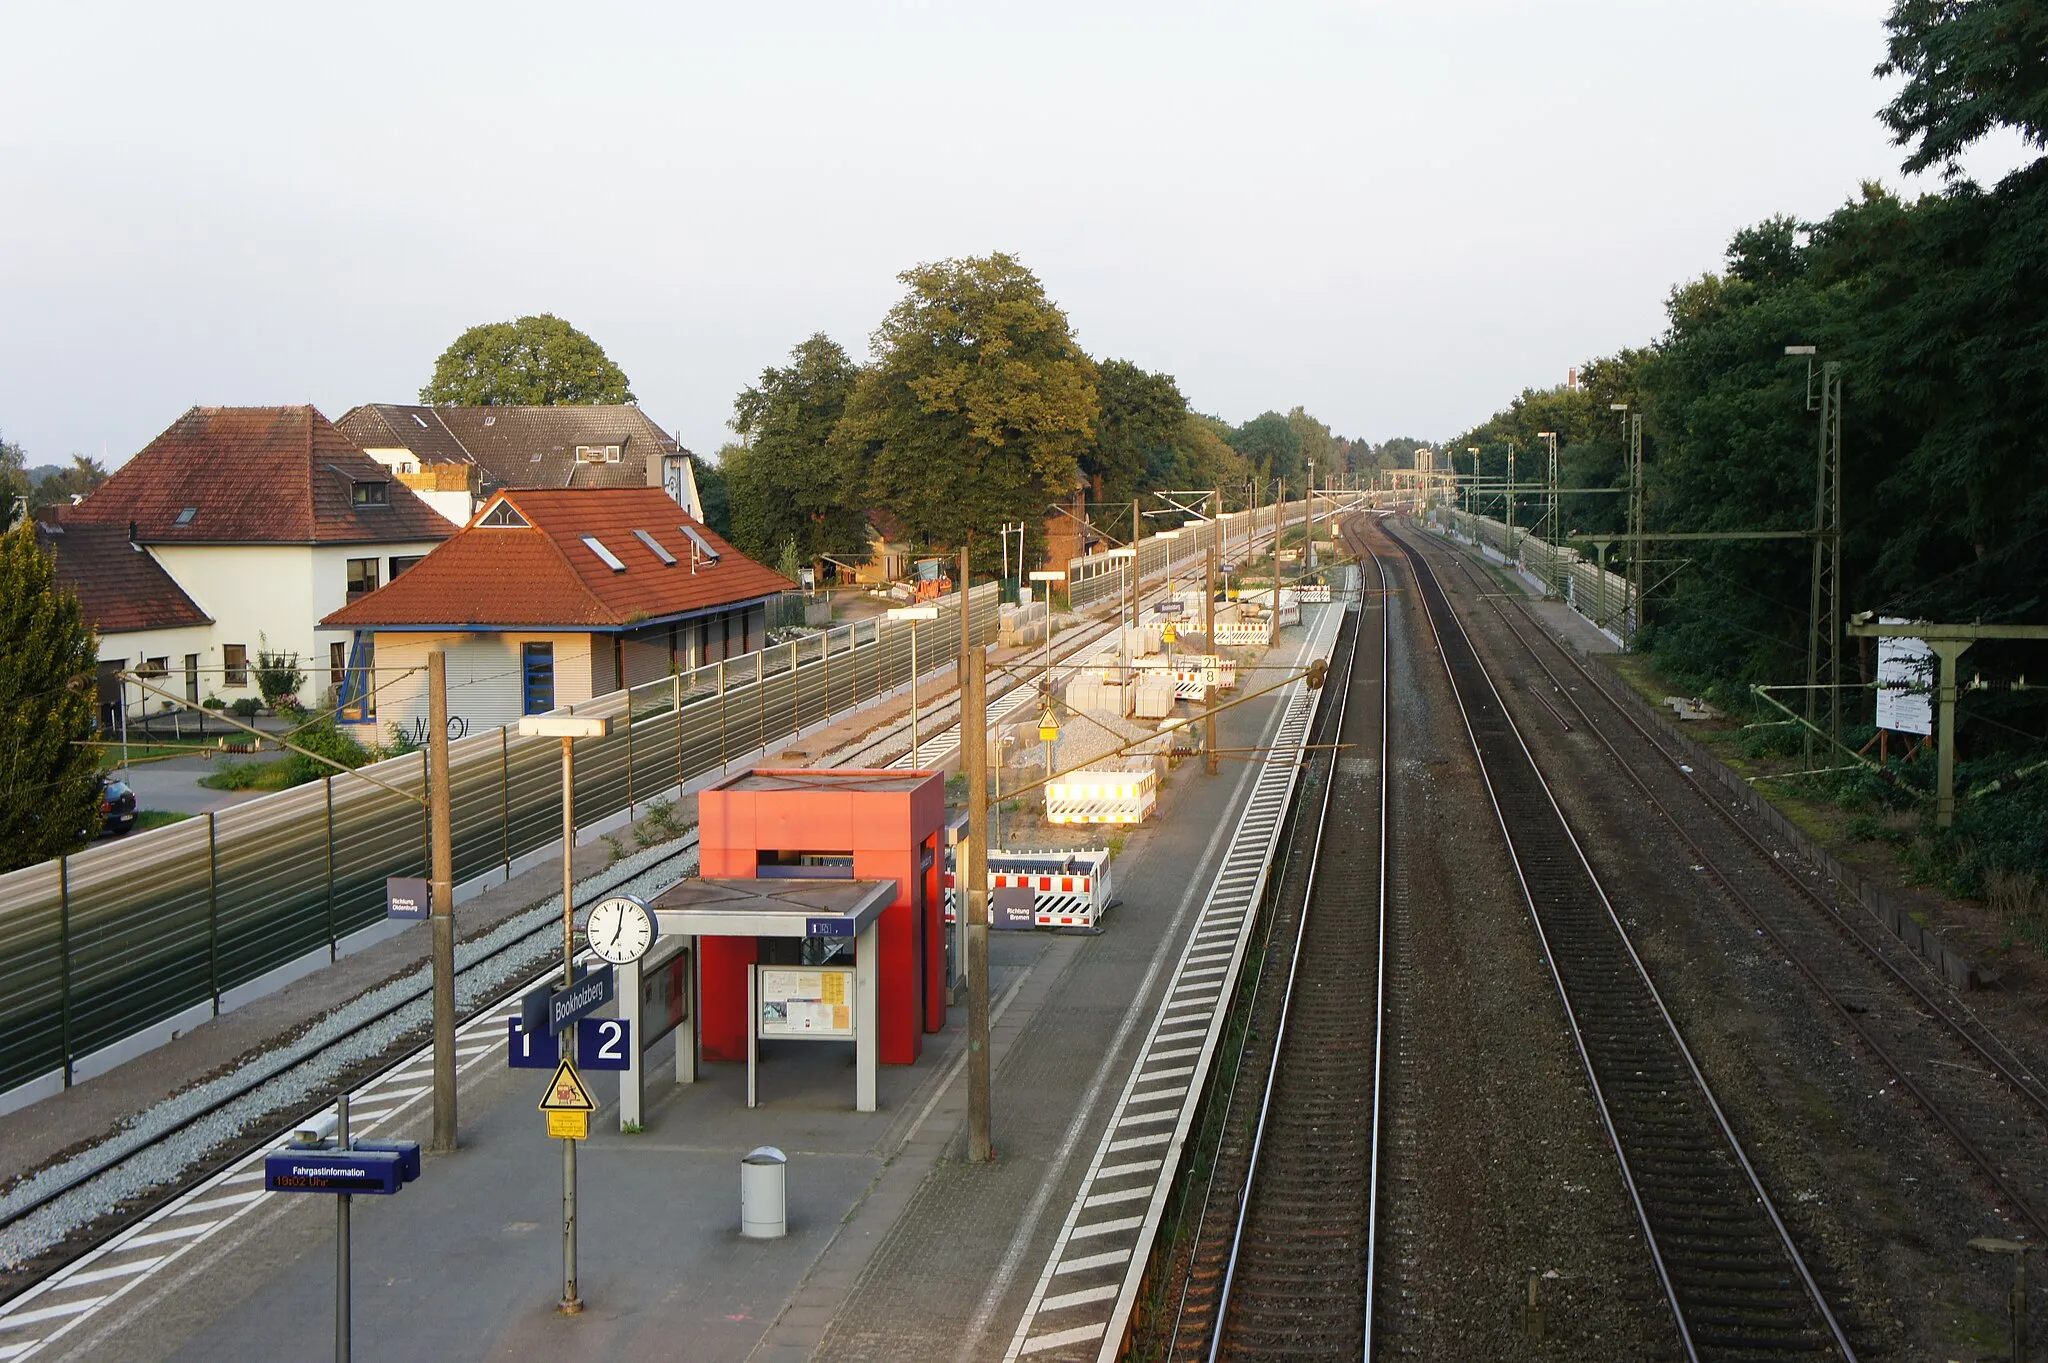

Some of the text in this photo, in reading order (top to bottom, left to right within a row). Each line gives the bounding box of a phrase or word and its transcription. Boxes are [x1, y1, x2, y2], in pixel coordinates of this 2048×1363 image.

[1204, 657, 1217, 668] 21
[1206, 670, 1214, 682] 8
[392, 904, 418, 912] Oldenburg
[1007, 907, 1030, 915] Richtung
[555, 981, 603, 1022] Bookholzberg
[514, 1024, 530, 1057] 1
[598, 1021, 622, 1059] 2
[292, 1166, 365, 1177] Fahrgastinformation
[309, 1176, 329, 1187] Uhr
